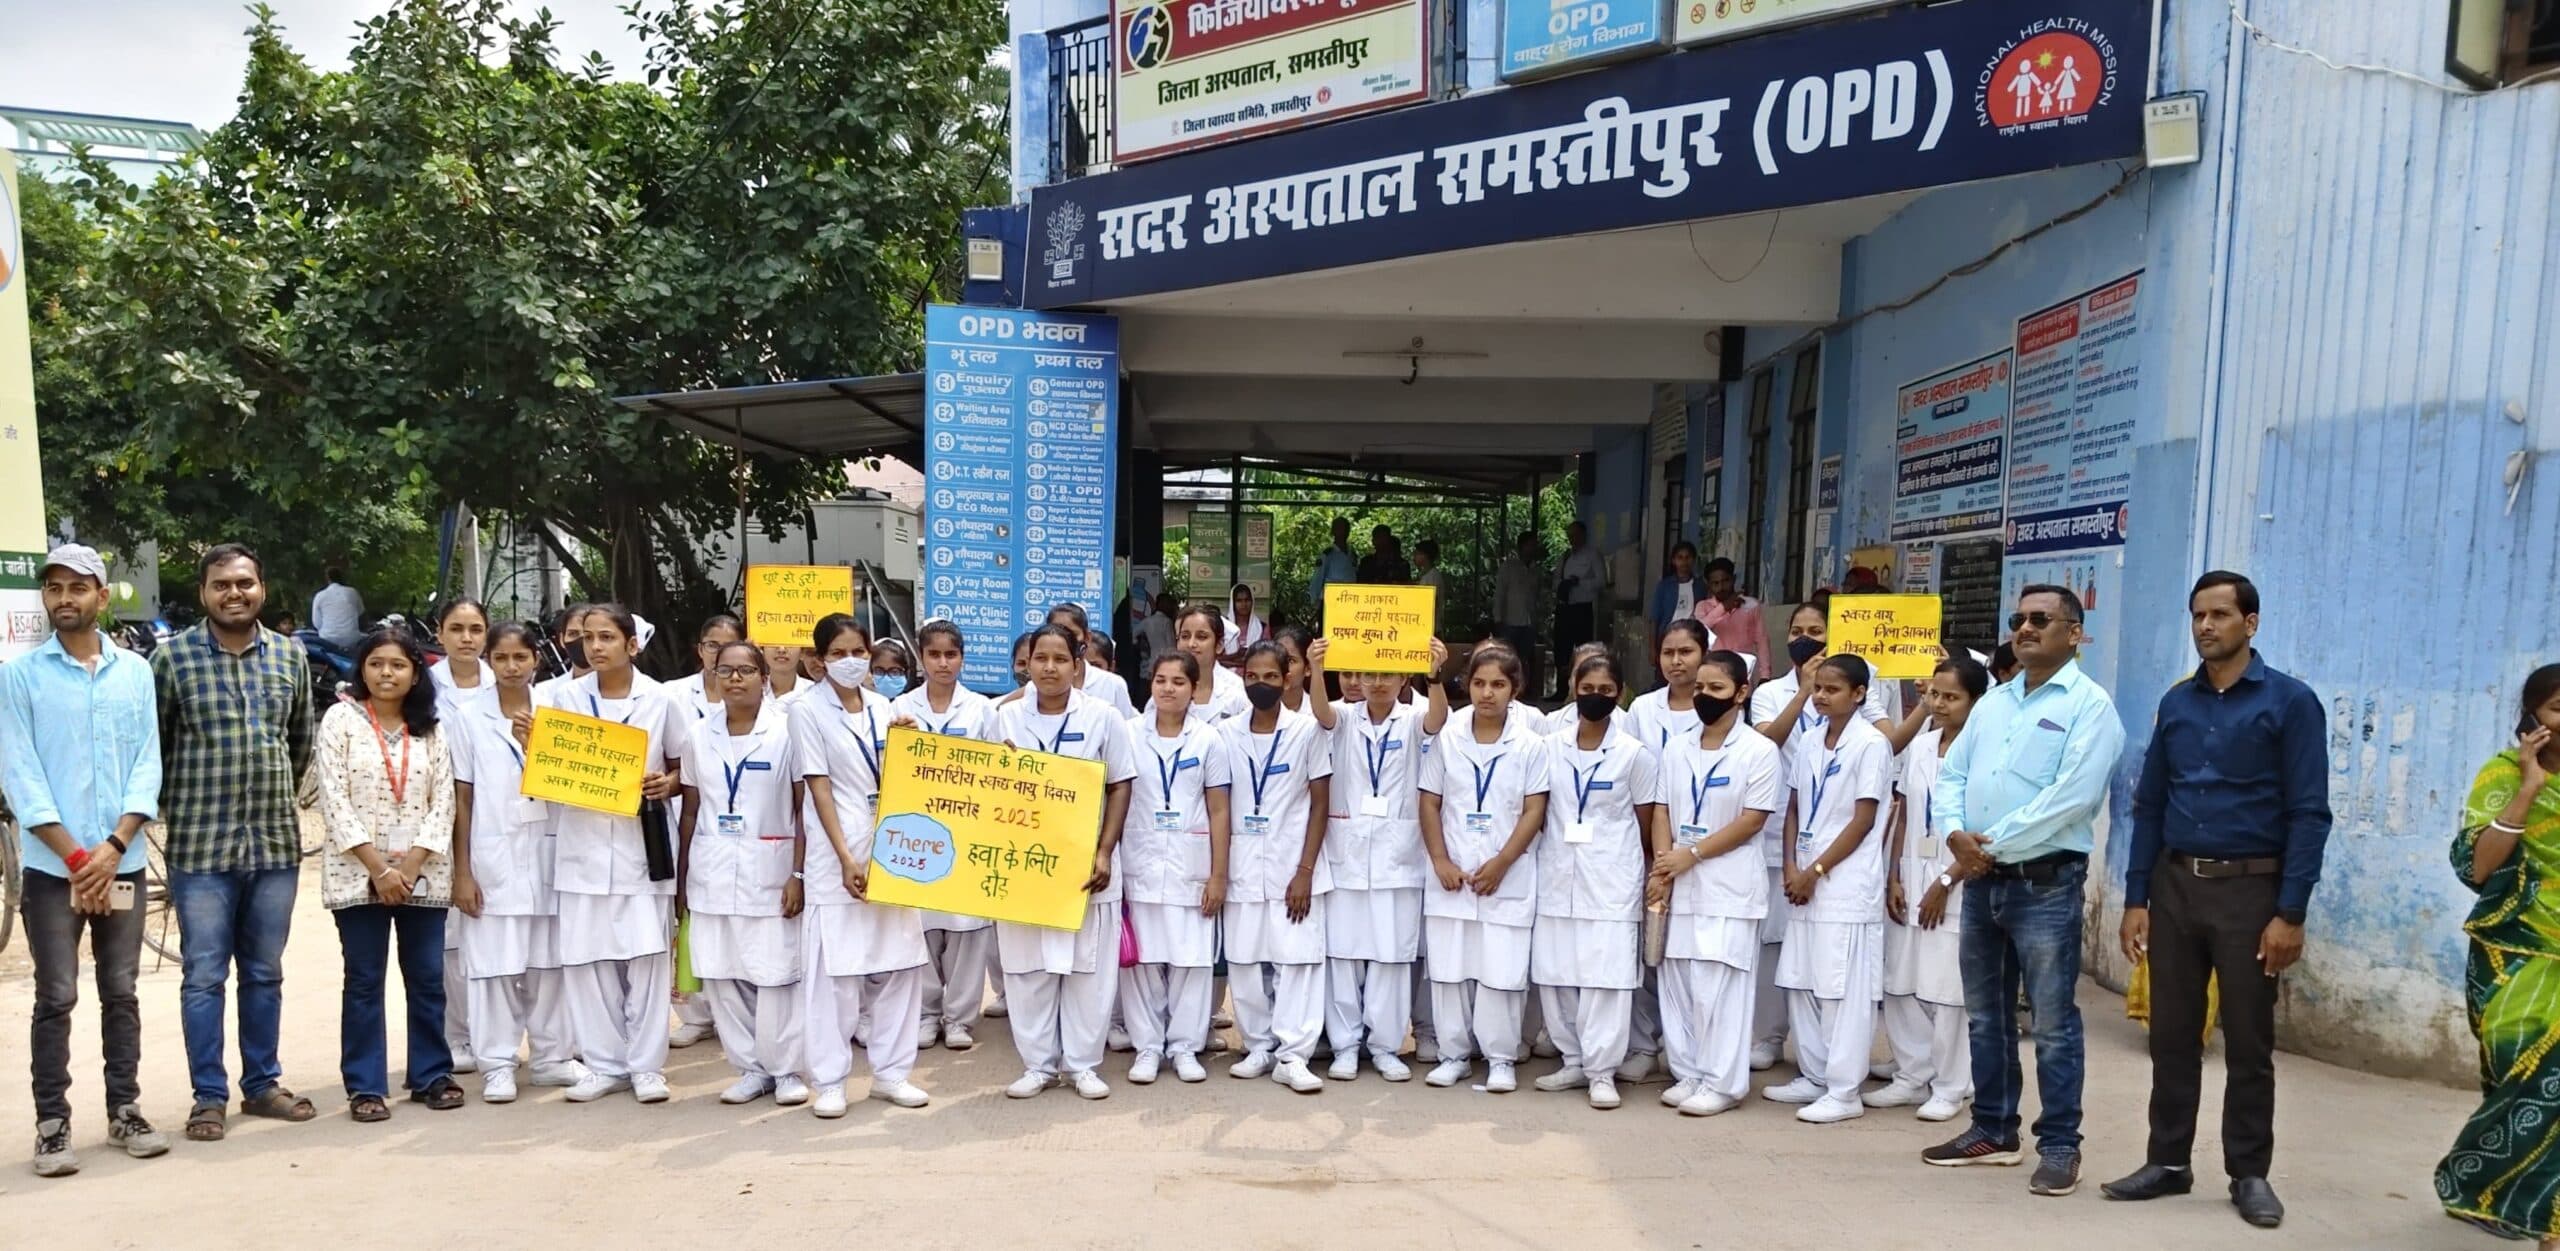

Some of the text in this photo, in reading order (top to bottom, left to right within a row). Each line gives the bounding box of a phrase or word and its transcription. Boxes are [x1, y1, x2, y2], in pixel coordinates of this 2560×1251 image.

[1548, 3, 1608, 35] OPD
[1559, 34, 1588, 50] रोग
[1158, 37, 1370, 105] जिला अस्पताल, समस्तीपुर
[1975, 17, 2118, 127] NATIONAL HEALTH MISSION
[1184, 119, 1205, 134] जिला
[1208, 112, 1235, 128] स्वास्थ्य
[1271, 95, 1311, 115] समस्तीपुर
[1097, 49, 1954, 261] सदर अस्पताल समस्तीपुर (OPD)
[959, 316, 1087, 343] OPD भवन
[951, 349, 998, 367] भू तल
[1034, 354, 1104, 370] प्रथम तल
[956, 372, 1012, 387] Enquiry
[1049, 379, 1105, 389] General OPD
[939, 407, 952, 418] E2
[956, 400, 1010, 415] Waiting Area
[1049, 422, 1090, 432] NCD Clinic
[938, 436, 951, 448] E3
[938, 464, 951, 477] E4
[954, 465, 970, 478] C.T.
[1049, 484, 1102, 496] T.B. OPD
[938, 493, 951, 505] E5
[956, 503, 1008, 514] ECG Room
[1071, 507, 1103, 515] Collection
[938, 522, 951, 534] E6
[2017, 507, 2116, 542] सदर अस्पताल समस्तीपुर
[1068, 528, 1101, 537] Collection
[938, 551, 950, 563] E7
[1029, 551, 1043, 559] E22
[1047, 547, 1100, 559] Pathology
[938, 580, 951, 592] E8
[954, 576, 1010, 590] X-ray Room
[1081, 591, 1100, 599] OPD
[954, 605, 1009, 618] ANC Clinic
[1028, 613, 1042, 621] E27
[15, 615, 42, 633] BSACS
[907, 737, 1047, 775] नीले आकाश के लिए
[1013, 780, 1040, 801] वायु
[1044, 780, 1077, 803] दिवस
[994, 807, 1041, 830] 2025
[886, 829, 946, 855] Theme
[891, 854, 927, 871] 2025
[968, 841, 1059, 878] हवा के लिए
